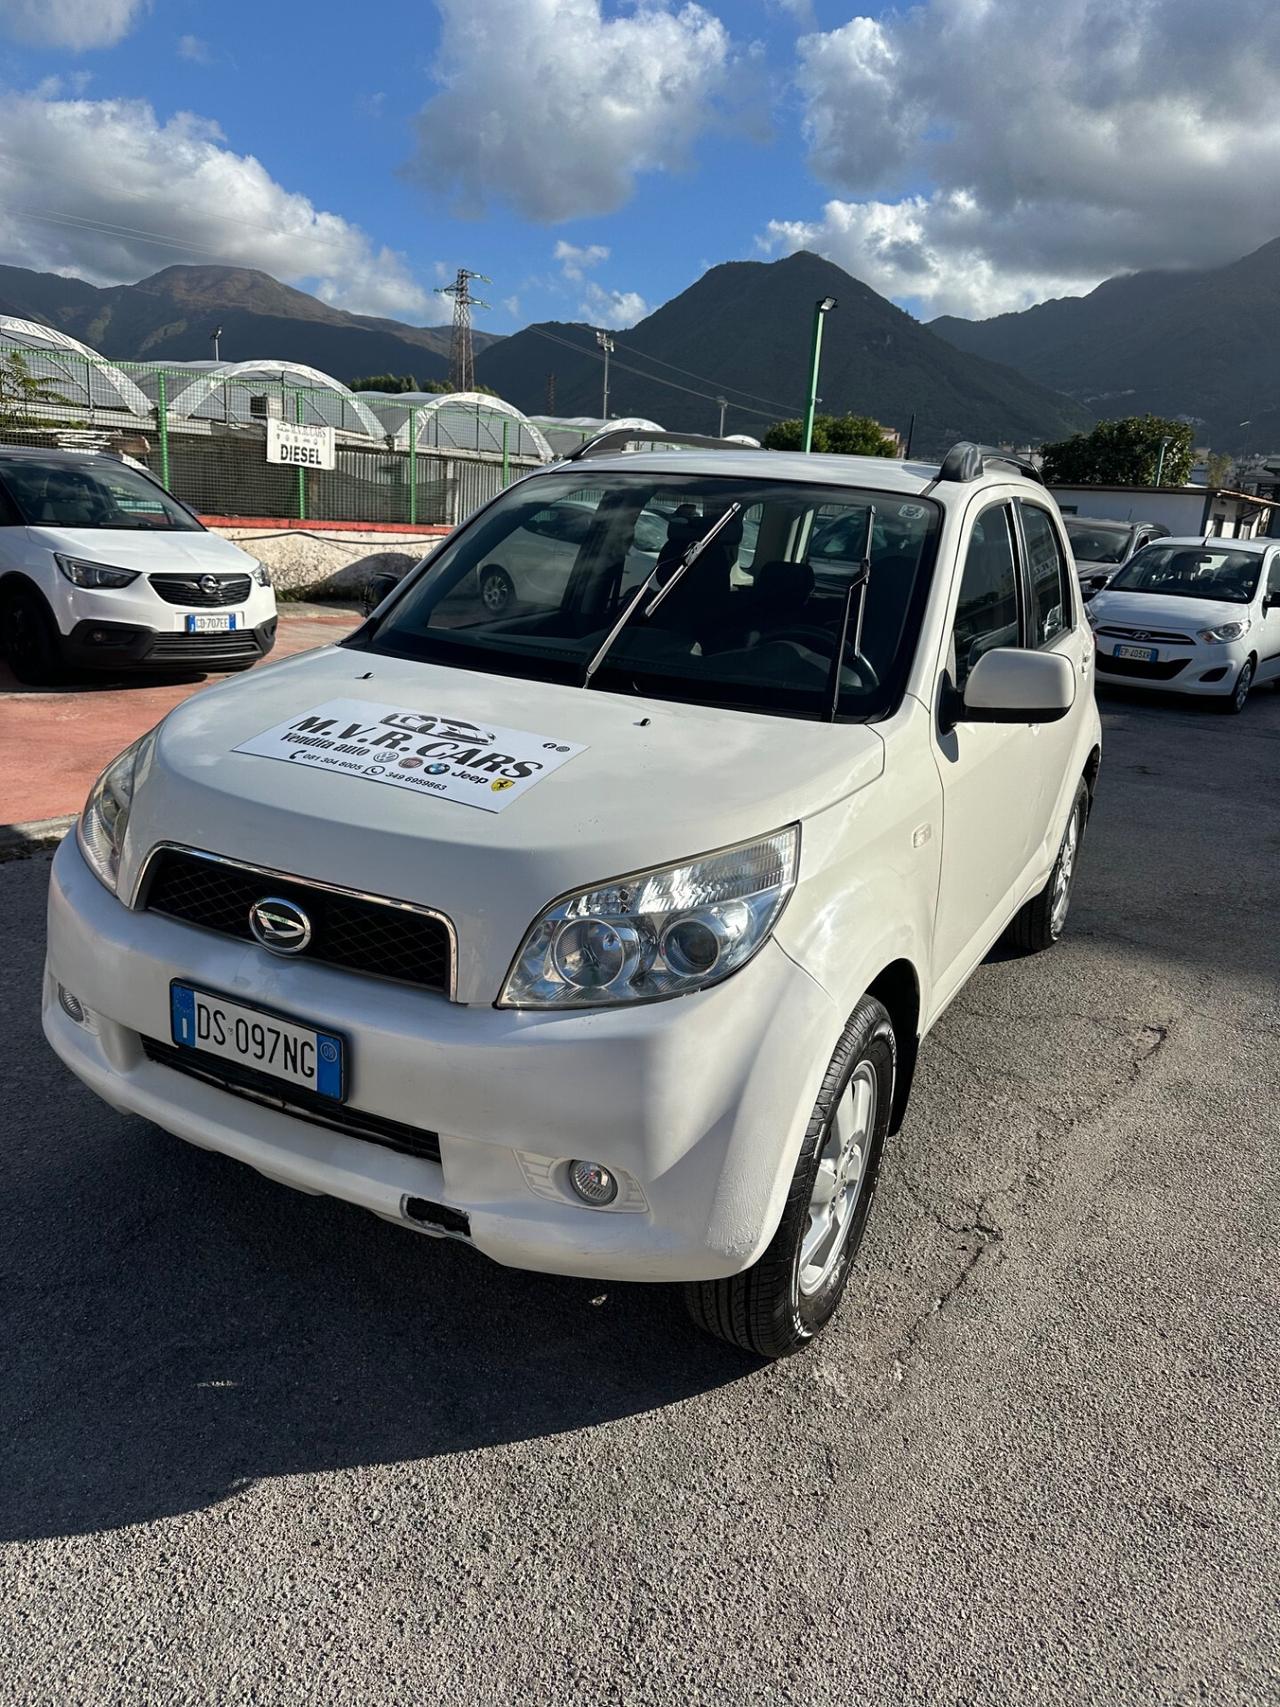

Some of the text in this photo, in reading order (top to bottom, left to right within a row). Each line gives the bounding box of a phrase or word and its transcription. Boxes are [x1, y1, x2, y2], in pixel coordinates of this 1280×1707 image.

[280, 444, 322, 465] DIESEL
[280, 732, 370, 756] Vendita auto
[302, 753, 364, 770] 081 304 8005
[385, 771, 447, 791] 349 6959863
[452, 770, 489, 784] Jeep
